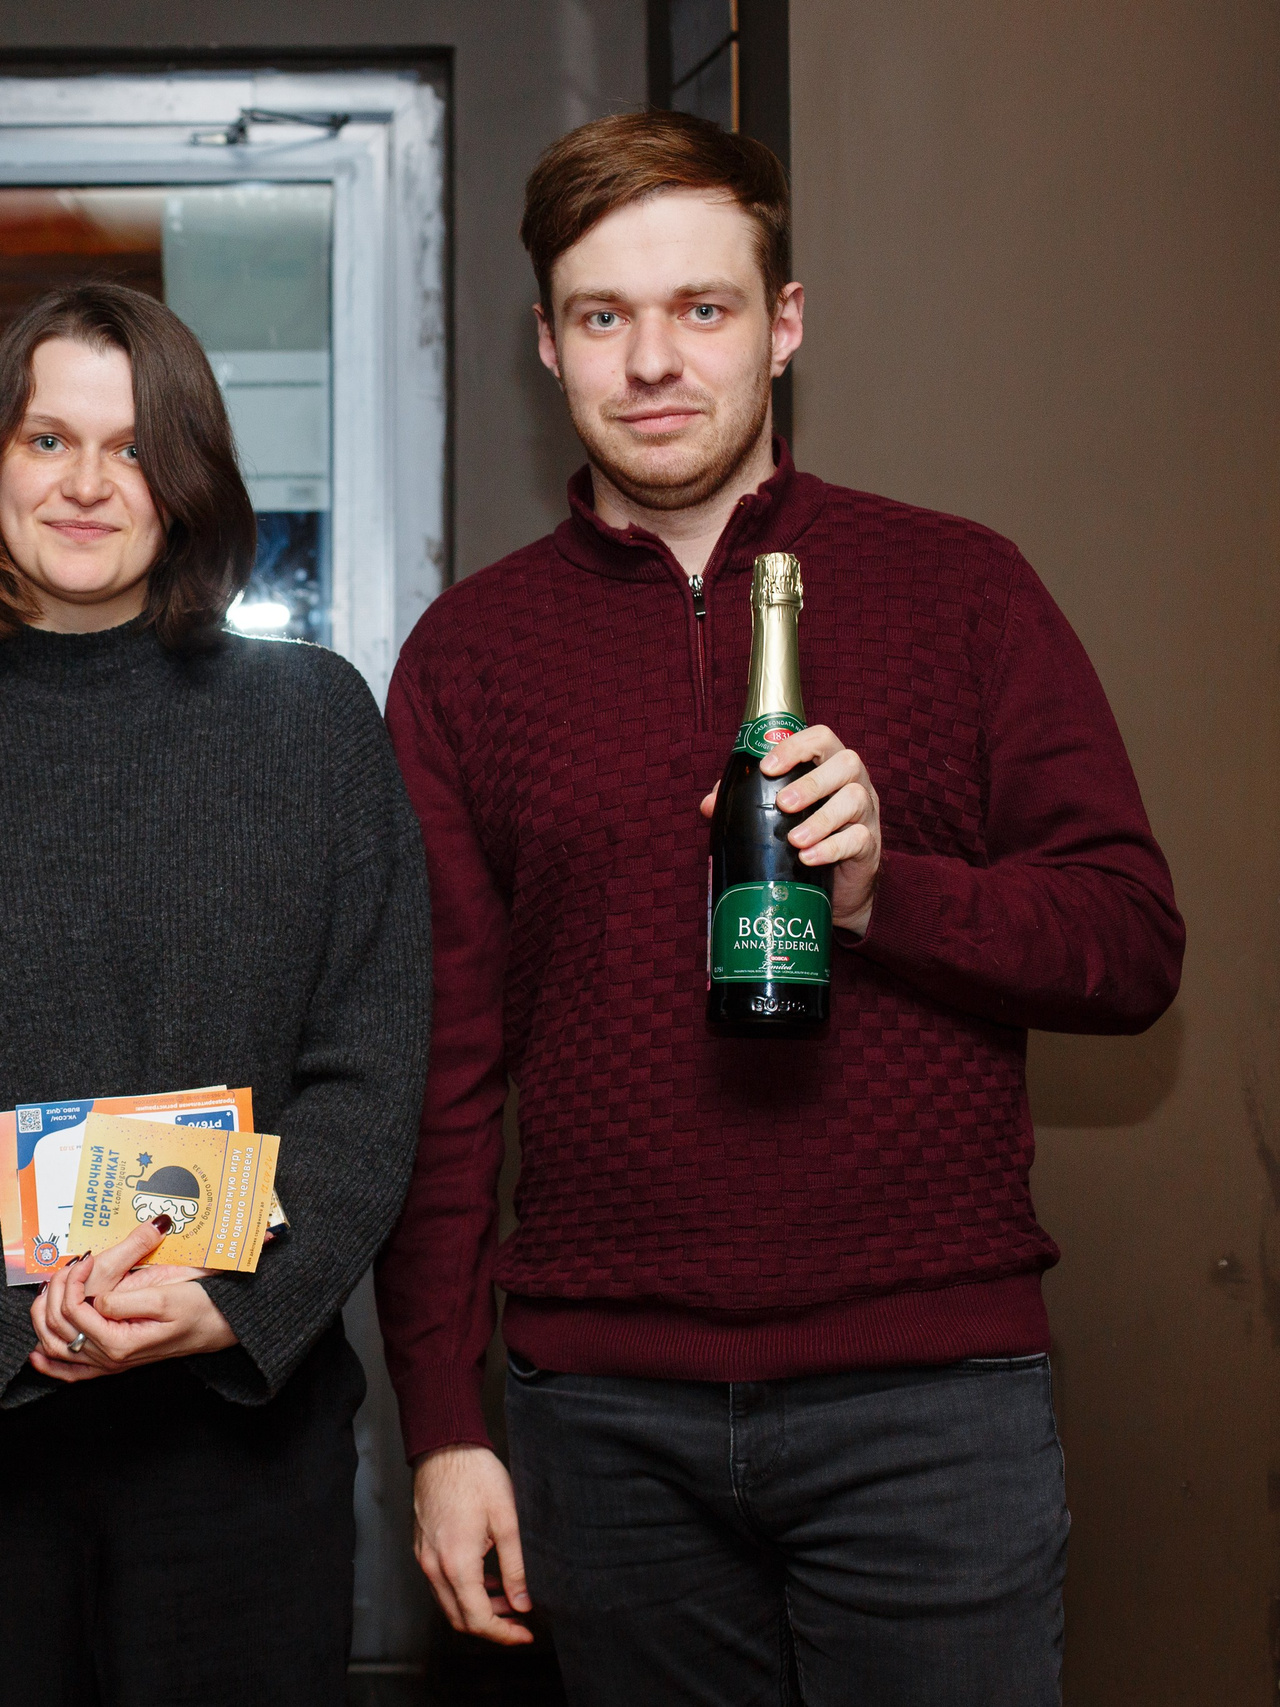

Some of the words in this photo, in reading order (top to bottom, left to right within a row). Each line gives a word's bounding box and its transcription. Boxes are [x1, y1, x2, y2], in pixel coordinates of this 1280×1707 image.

[754, 723, 767, 734] CASA
[768, 720, 795, 728] FONDATA
[772, 732, 790, 740] 1831
[755, 740, 770, 750] LUIGI
[738, 916, 817, 939] BOSCA
[733, 940, 767, 950] ANNA
[772, 940, 820, 952] FEDERICA
[759, 960, 795, 970] Lmited
[46, 1106, 81, 1115] BUBO_QUIZ
[179, 1098, 236, 1108] Предварительная
[230, 1148, 242, 1173] игру
[192, 1164, 208, 1183] квиза
[239, 1146, 254, 1197] человека
[82, 1145, 105, 1227] ПОДАРОЧНЫЙ
[98, 1149, 120, 1227] СЕРТИФИКАТ
[113, 1160, 127, 1215] vk.com/bigquiz
[201, 1184, 213, 1220] большого
[216, 1176, 237, 1240] бесплатную
[232, 1200, 246, 1238] одного
[182, 1221, 205, 1240] теория
[215, 1242, 225, 1254] на
[227, 1240, 238, 1259] для
